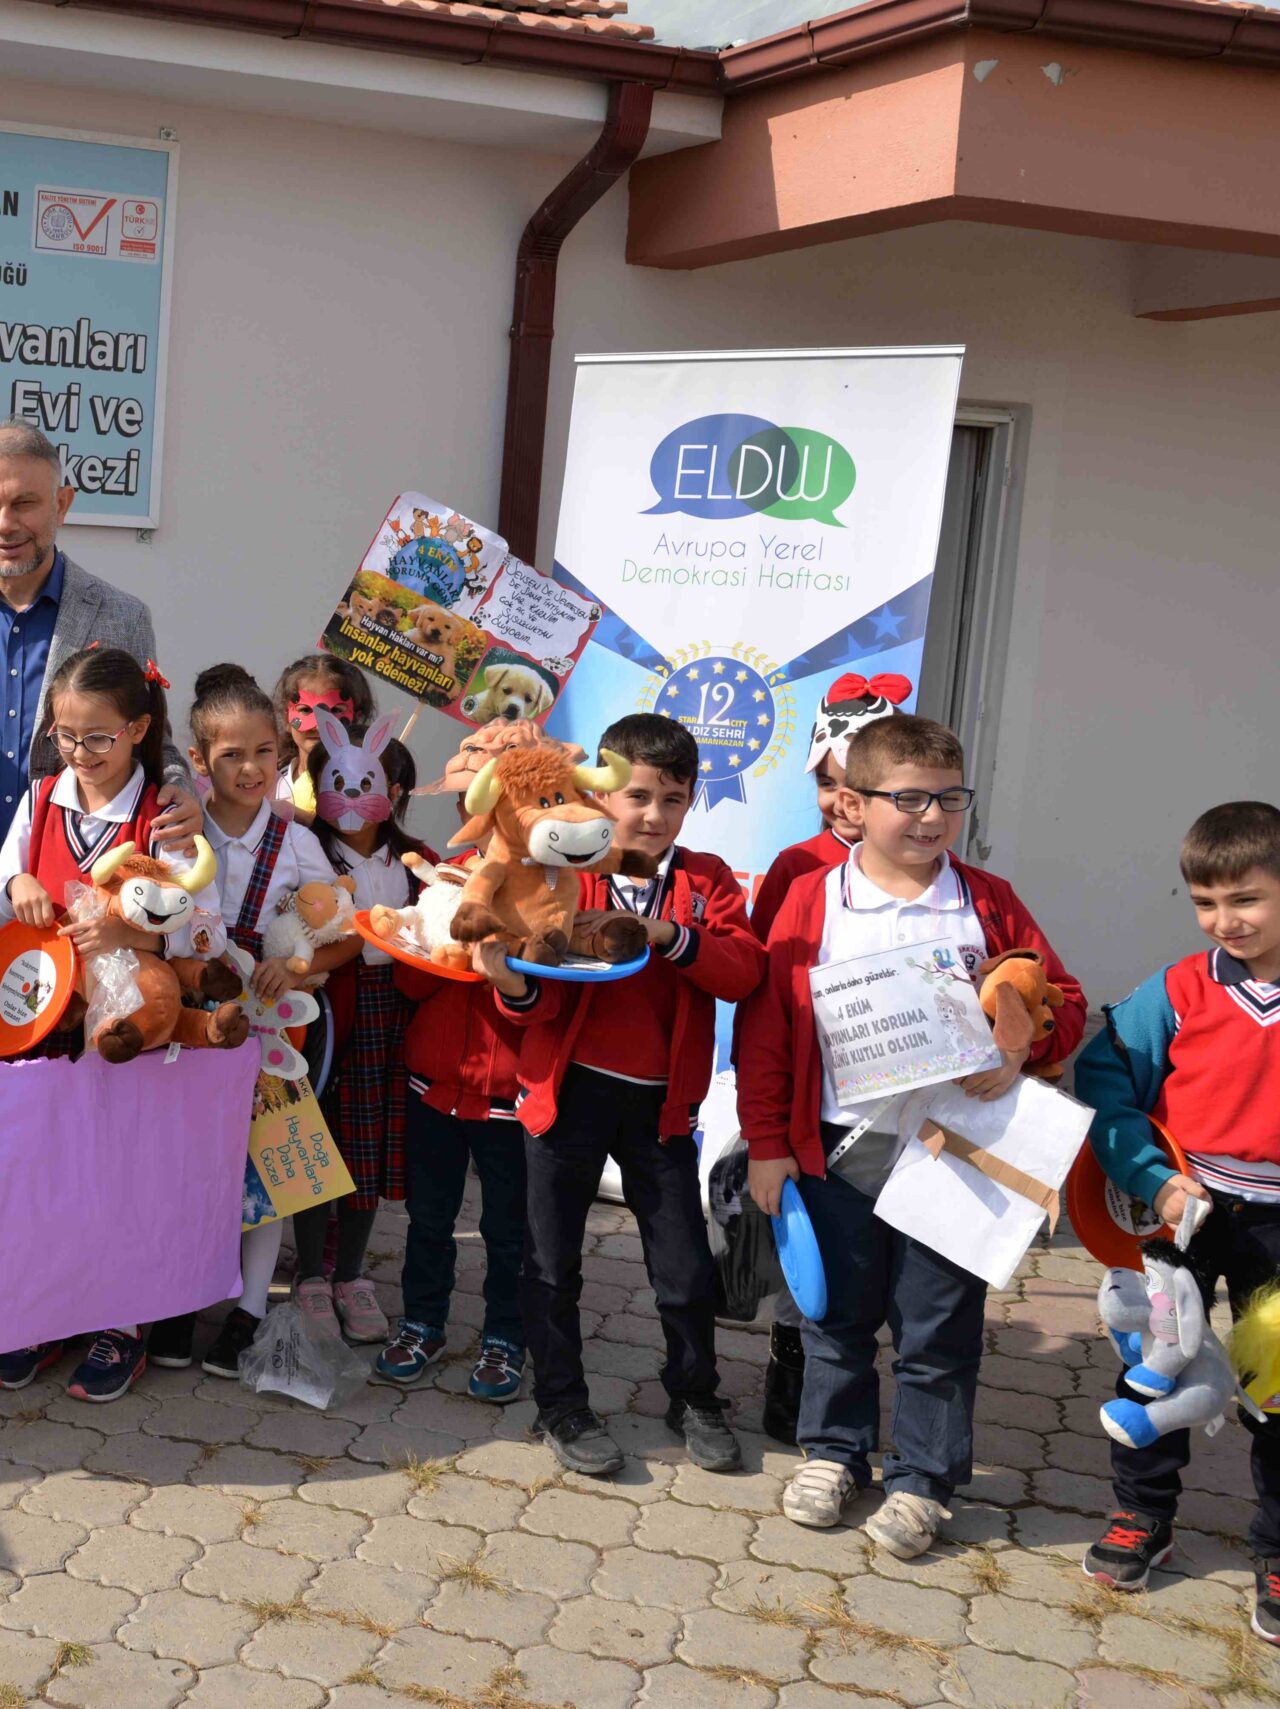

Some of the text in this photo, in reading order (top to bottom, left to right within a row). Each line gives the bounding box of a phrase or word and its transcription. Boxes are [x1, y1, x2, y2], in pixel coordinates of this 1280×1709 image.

[73, 243, 104, 253] ISO 9001
[11, 379, 81, 433] Evi
[89, 395, 144, 437] ve
[55, 443, 140, 496] kezi
[654, 533, 824, 562] Avrupa Yerel
[621, 558, 851, 591] Demokrasi Haftası
[340, 616, 453, 689] İnsanlar hayvanları
[361, 615, 388, 635] Hayvan
[389, 630, 416, 651] Hakları
[416, 644, 428, 658] var
[349, 647, 427, 694] yok edemez!
[697, 682, 734, 725] 12
[847, 977, 863, 988] daha
[838, 997, 873, 1020] 4 EKİM
[872, 1008, 928, 1036] KORUMA
[850, 1043, 886, 1064] KUTLU
[888, 1031, 933, 1054] OLSUN.
[261, 1147, 285, 1187] Güzel
[277, 1144, 295, 1179] Daha
[286, 1115, 324, 1195] Hayvanlarla
[309, 1132, 330, 1168] Doğa
